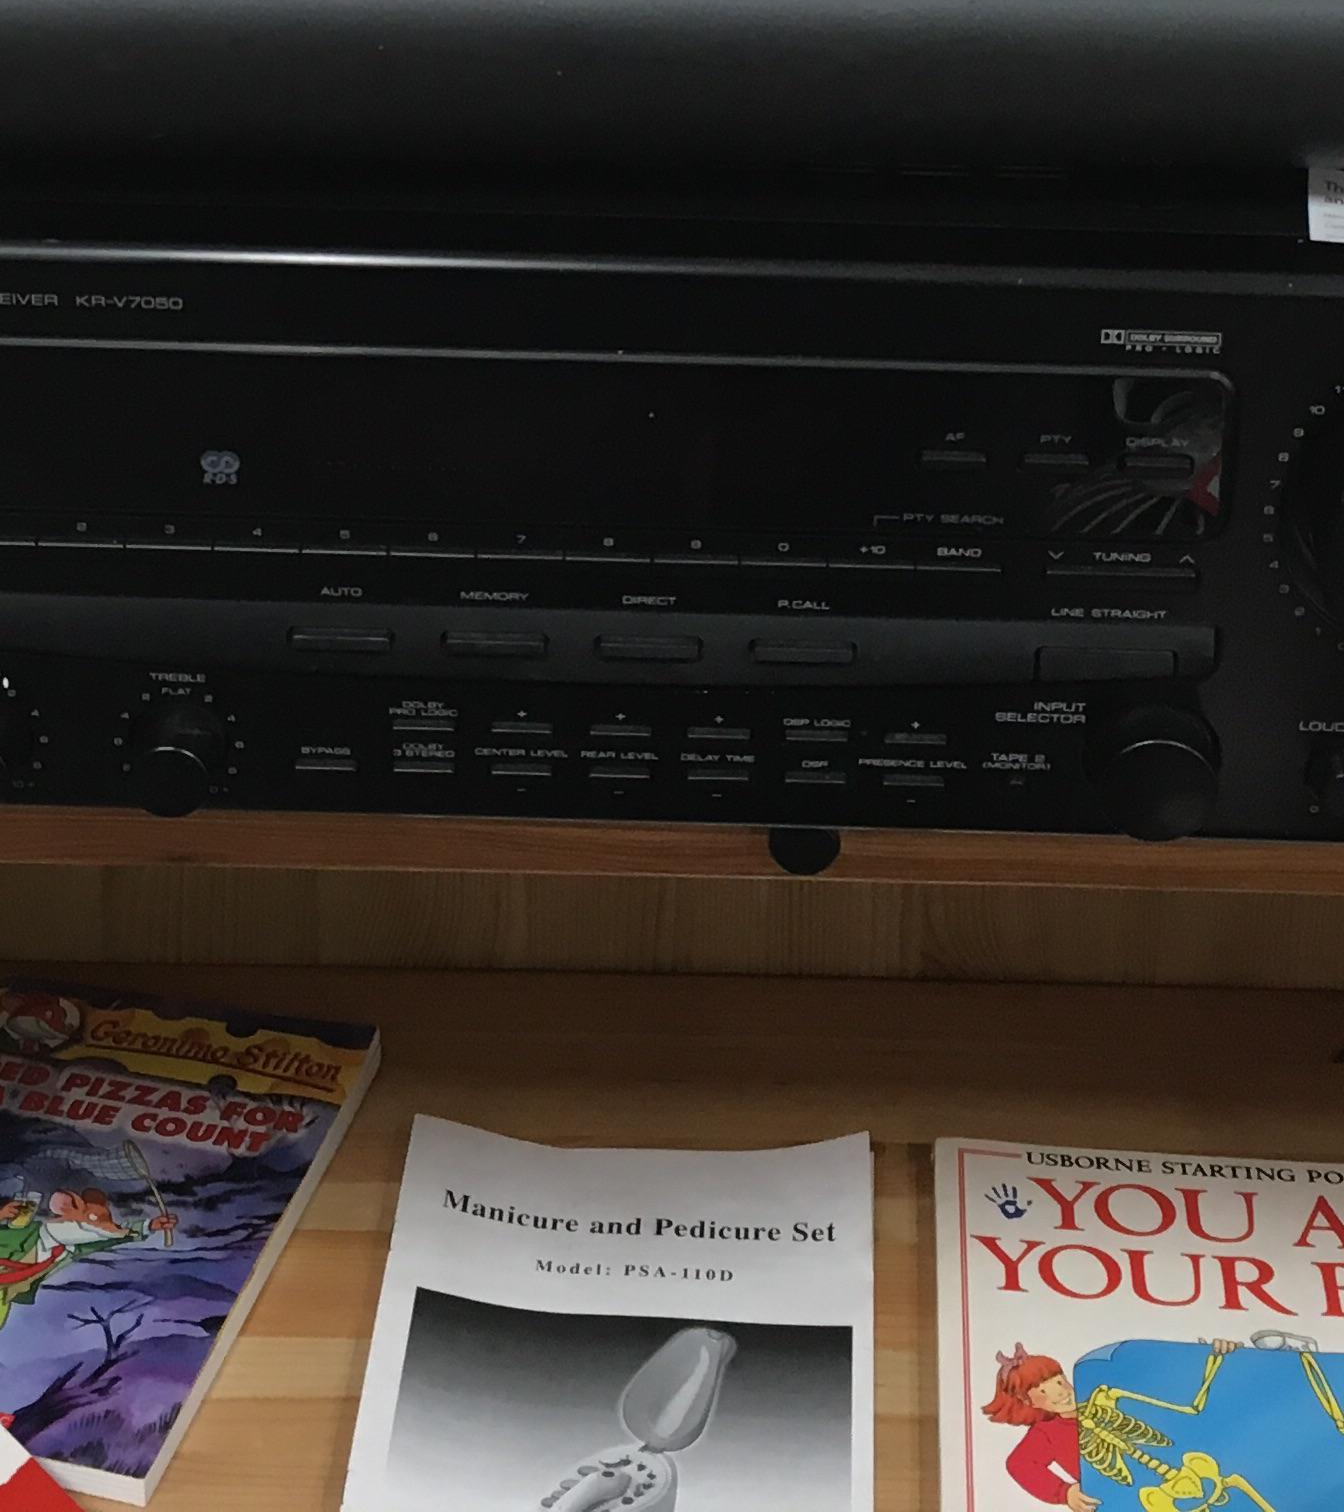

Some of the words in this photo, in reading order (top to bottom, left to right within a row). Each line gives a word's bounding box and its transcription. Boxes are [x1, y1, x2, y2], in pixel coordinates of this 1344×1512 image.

[940, 513, 1004, 526] SEARCH
[936, 547, 983, 559] BAND
[1092, 550, 1152, 564] TUNING
[321, 586, 363, 597] AUTO
[459, 590, 530, 602] MEMORY
[621, 594, 678, 606] DIRECT
[1051, 607, 1085, 618] LINE
[1091, 608, 1168, 619] STRAIGHT
[148, 672, 206, 684] TREBLE
[161, 687, 192, 696] FLAT
[1034, 702, 1087, 713] INPUT
[995, 711, 1087, 724] SELECTOR
[474, 747, 526, 757] CENTER
[530, 748, 568, 759] LEVEL
[580, 750, 616, 759] REAR
[620, 751, 659, 761] LEVEL
[680, 752, 721, 762] DELAY
[725, 754, 755, 763] TIME
[991, 753, 1028, 762] TAPE
[858, 758, 925, 768] PRESENCE
[930, 760, 968, 769] LEVEL
[90, 1018, 230, 1067] Geronimo
[236, 1041, 344, 1084] Stilton
[65, 1072, 208, 1115] PIZZAS
[218, 1094, 306, 1132] FOR
[26, 1089, 118, 1126] BLUE
[129, 1110, 270, 1153] COUNT
[1025, 1150, 1152, 1174] USBORNE
[1162, 1160, 1296, 1183] STARTING
[1028, 1175, 1259, 1244] YOU
[443, 1189, 578, 1232] Manicure
[589, 1217, 642, 1236] and
[653, 1217, 781, 1243] Pedicure
[791, 1222, 837, 1243] Set
[535, 1259, 611, 1276] Model:
[624, 1264, 734, 1283] PSA-110D
[970, 1235, 1299, 1318] YOUR
